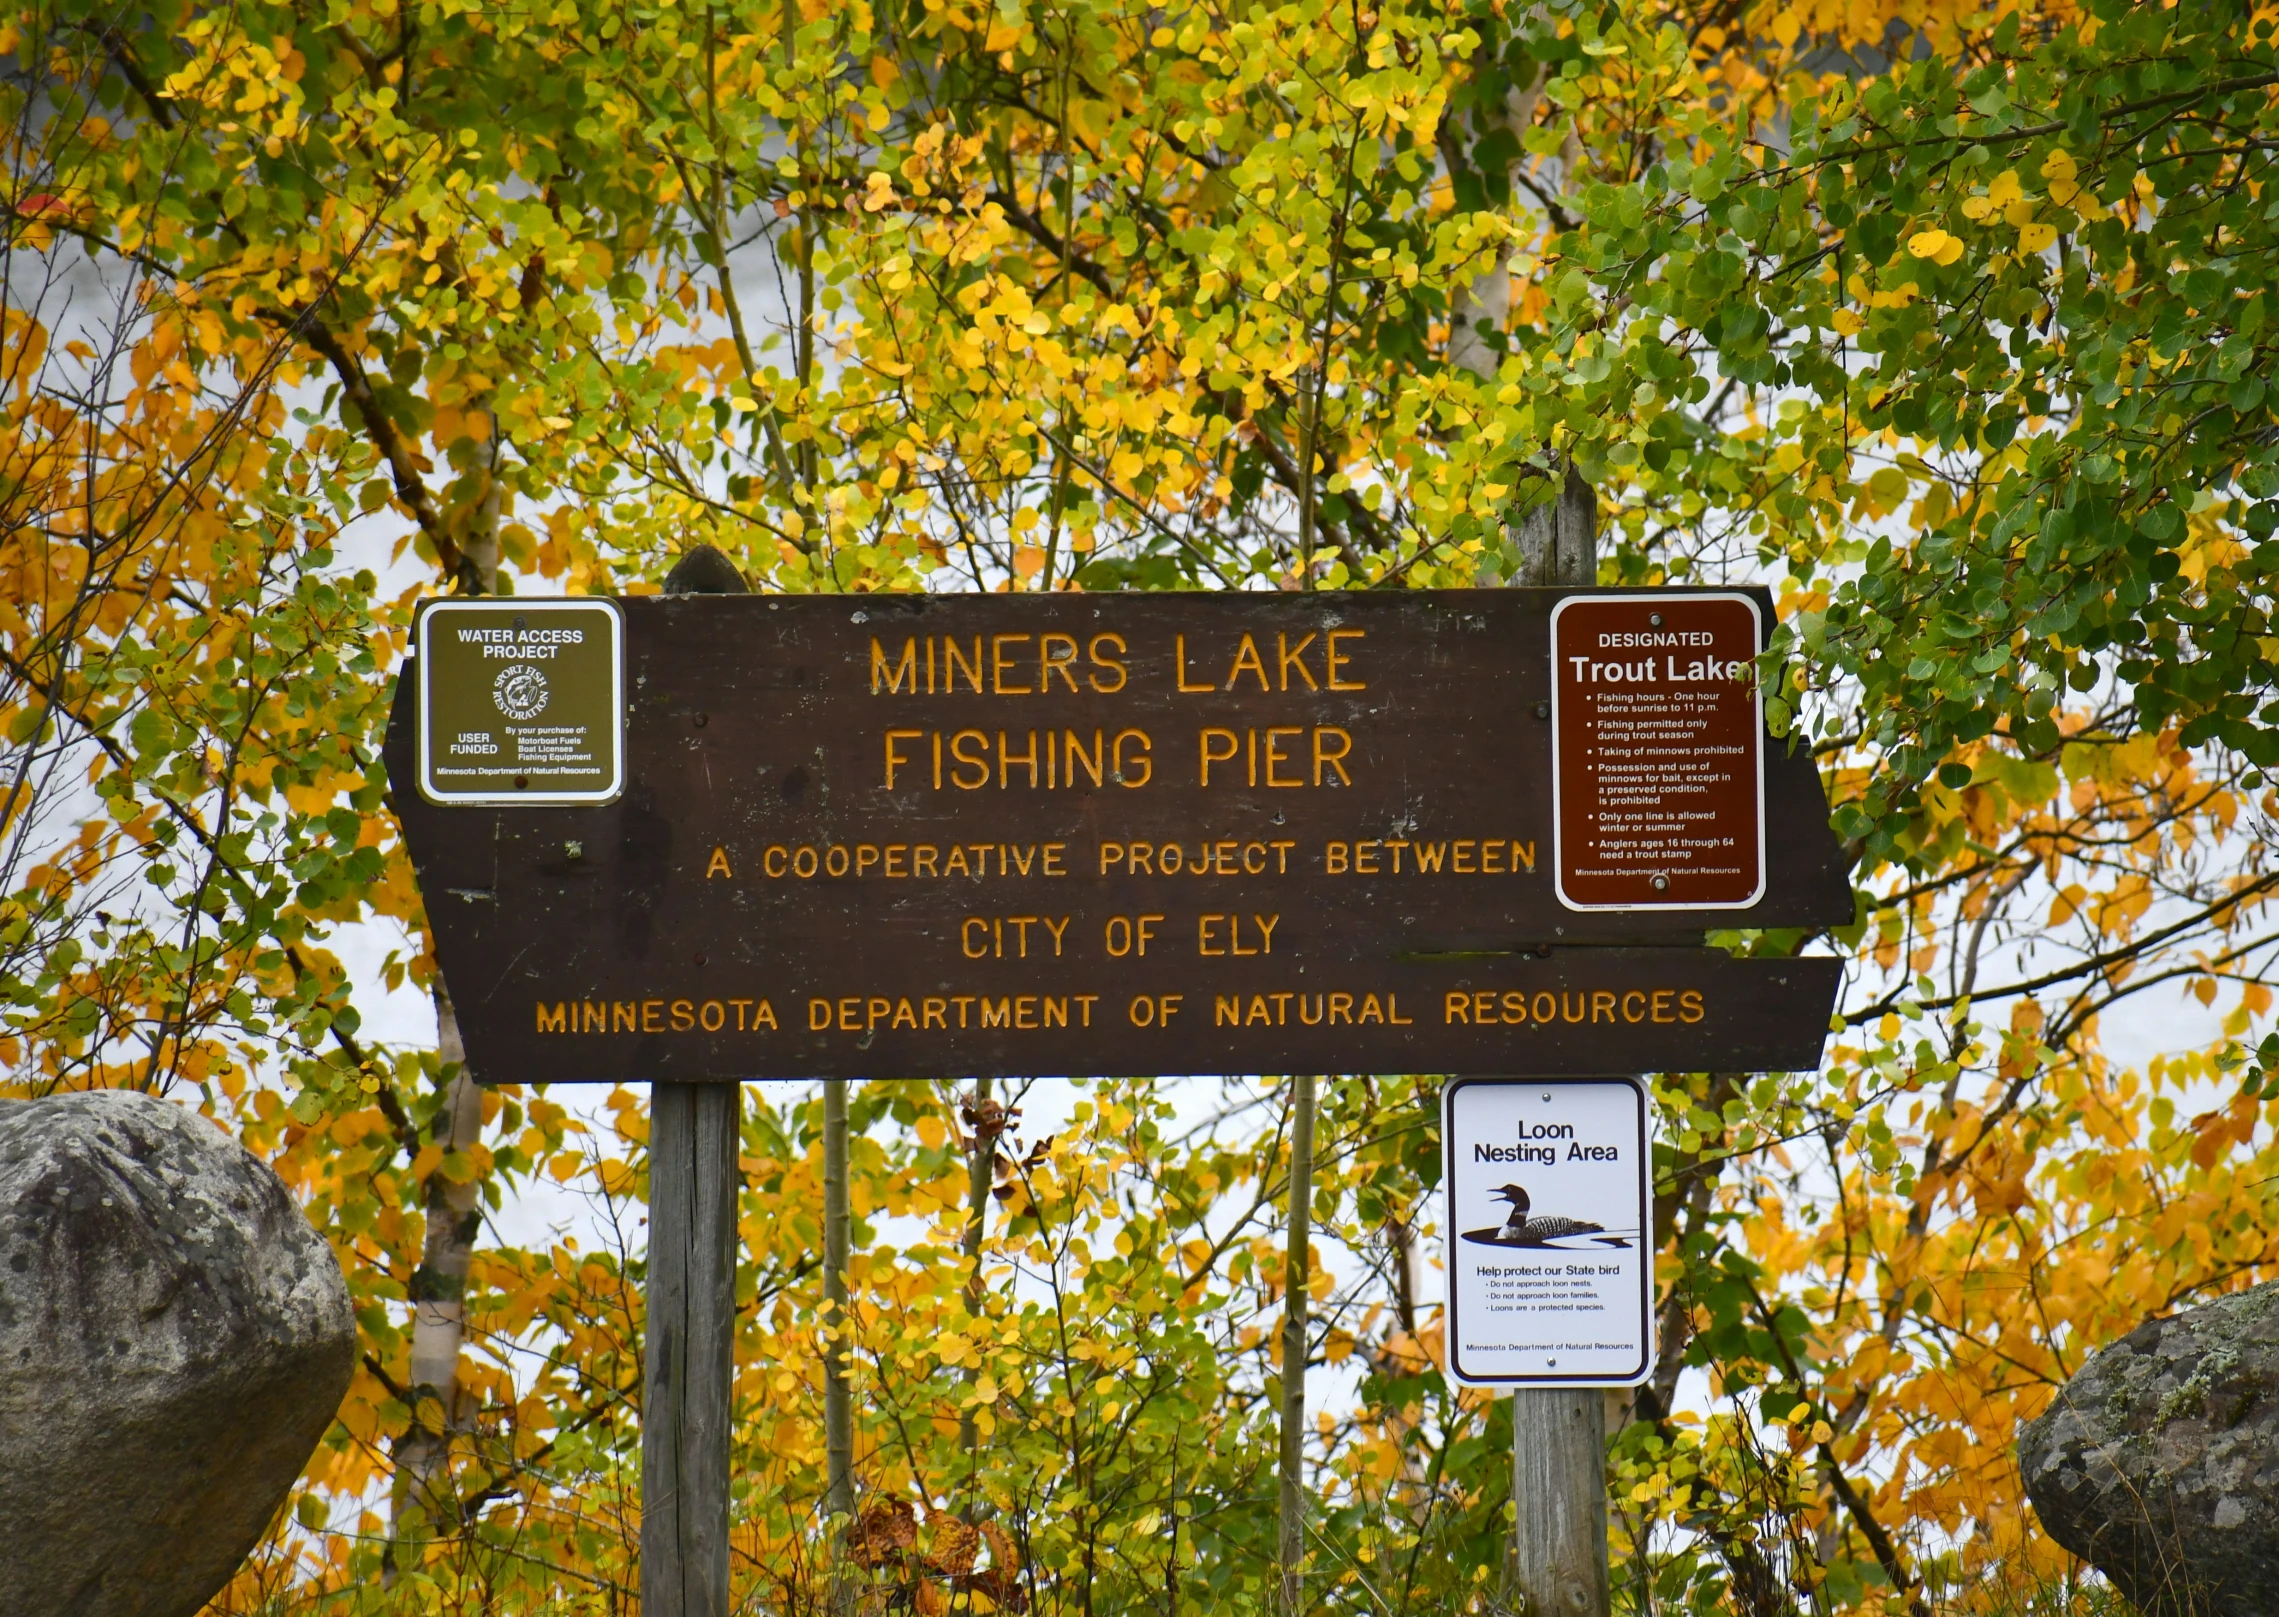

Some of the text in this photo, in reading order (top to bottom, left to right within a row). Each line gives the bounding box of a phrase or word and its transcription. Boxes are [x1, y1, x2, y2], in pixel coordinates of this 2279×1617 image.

[458, 630, 583, 643] WATER ACCESS
[1599, 632, 1713, 647] DESIGNATED
[484, 646, 558, 658] PROJECT
[869, 630, 1368, 696] MINERS LAKE
[1569, 655, 1743, 683] Trout Lake
[494, 665, 547, 688] SPORT FISH
[1597, 693, 1634, 703] Fishing
[1636, 692, 1665, 701] hours
[1674, 692, 1694, 701] One
[1697, 692, 1720, 700] hour
[493, 691, 549, 720] RESTORATION
[1597, 704, 1719, 713] before sunrise to 11 p.m.
[1597, 719, 1707, 730] Fishing permitted only
[459, 733, 489, 743] USER
[1598, 731, 1694, 741] during trout season
[450, 745, 498, 754] FUNDED
[1598, 746, 1744, 757] Taking of minnows prohibited
[884, 726, 1354, 792] FISHING PIER
[1598, 763, 1655, 772] Possession
[1658, 763, 1676, 771] and
[1699, 762, 1710, 770] of
[1599, 773, 1731, 783] minnows for bait, except in
[1607, 785, 1656, 795] preserved
[1659, 784, 1708, 794] condition,
[1599, 796, 1660, 806] is prohibited
[1599, 812, 1622, 823] Only
[1646, 812, 1664, 820] line
[1667, 812, 1675, 820] is
[1678, 811, 1716, 820] allowed
[1599, 824, 1629, 832] winter
[1645, 824, 1686, 832] summer
[1599, 838, 1734, 850] Anglers ages 16 through 64
[706, 840, 1538, 880] A COOPERATIVE PROJECT BETWEEN
[1600, 850, 1692, 859] need a trout stamp
[1616, 868, 1659, 876] Department
[961, 915, 1280, 960] CITY OF ELY
[535, 990, 1706, 1034] MINNESOTA DEPARTMENT OF NATURAL RESOURCES
[1518, 1120, 1573, 1139] Loon
[1475, 1143, 1617, 1165] Nesting Area
[1477, 1265, 1619, 1277] Help protect our State bird
[1517, 1292, 1550, 1300] approach
[1509, 1344, 1553, 1352] Department
